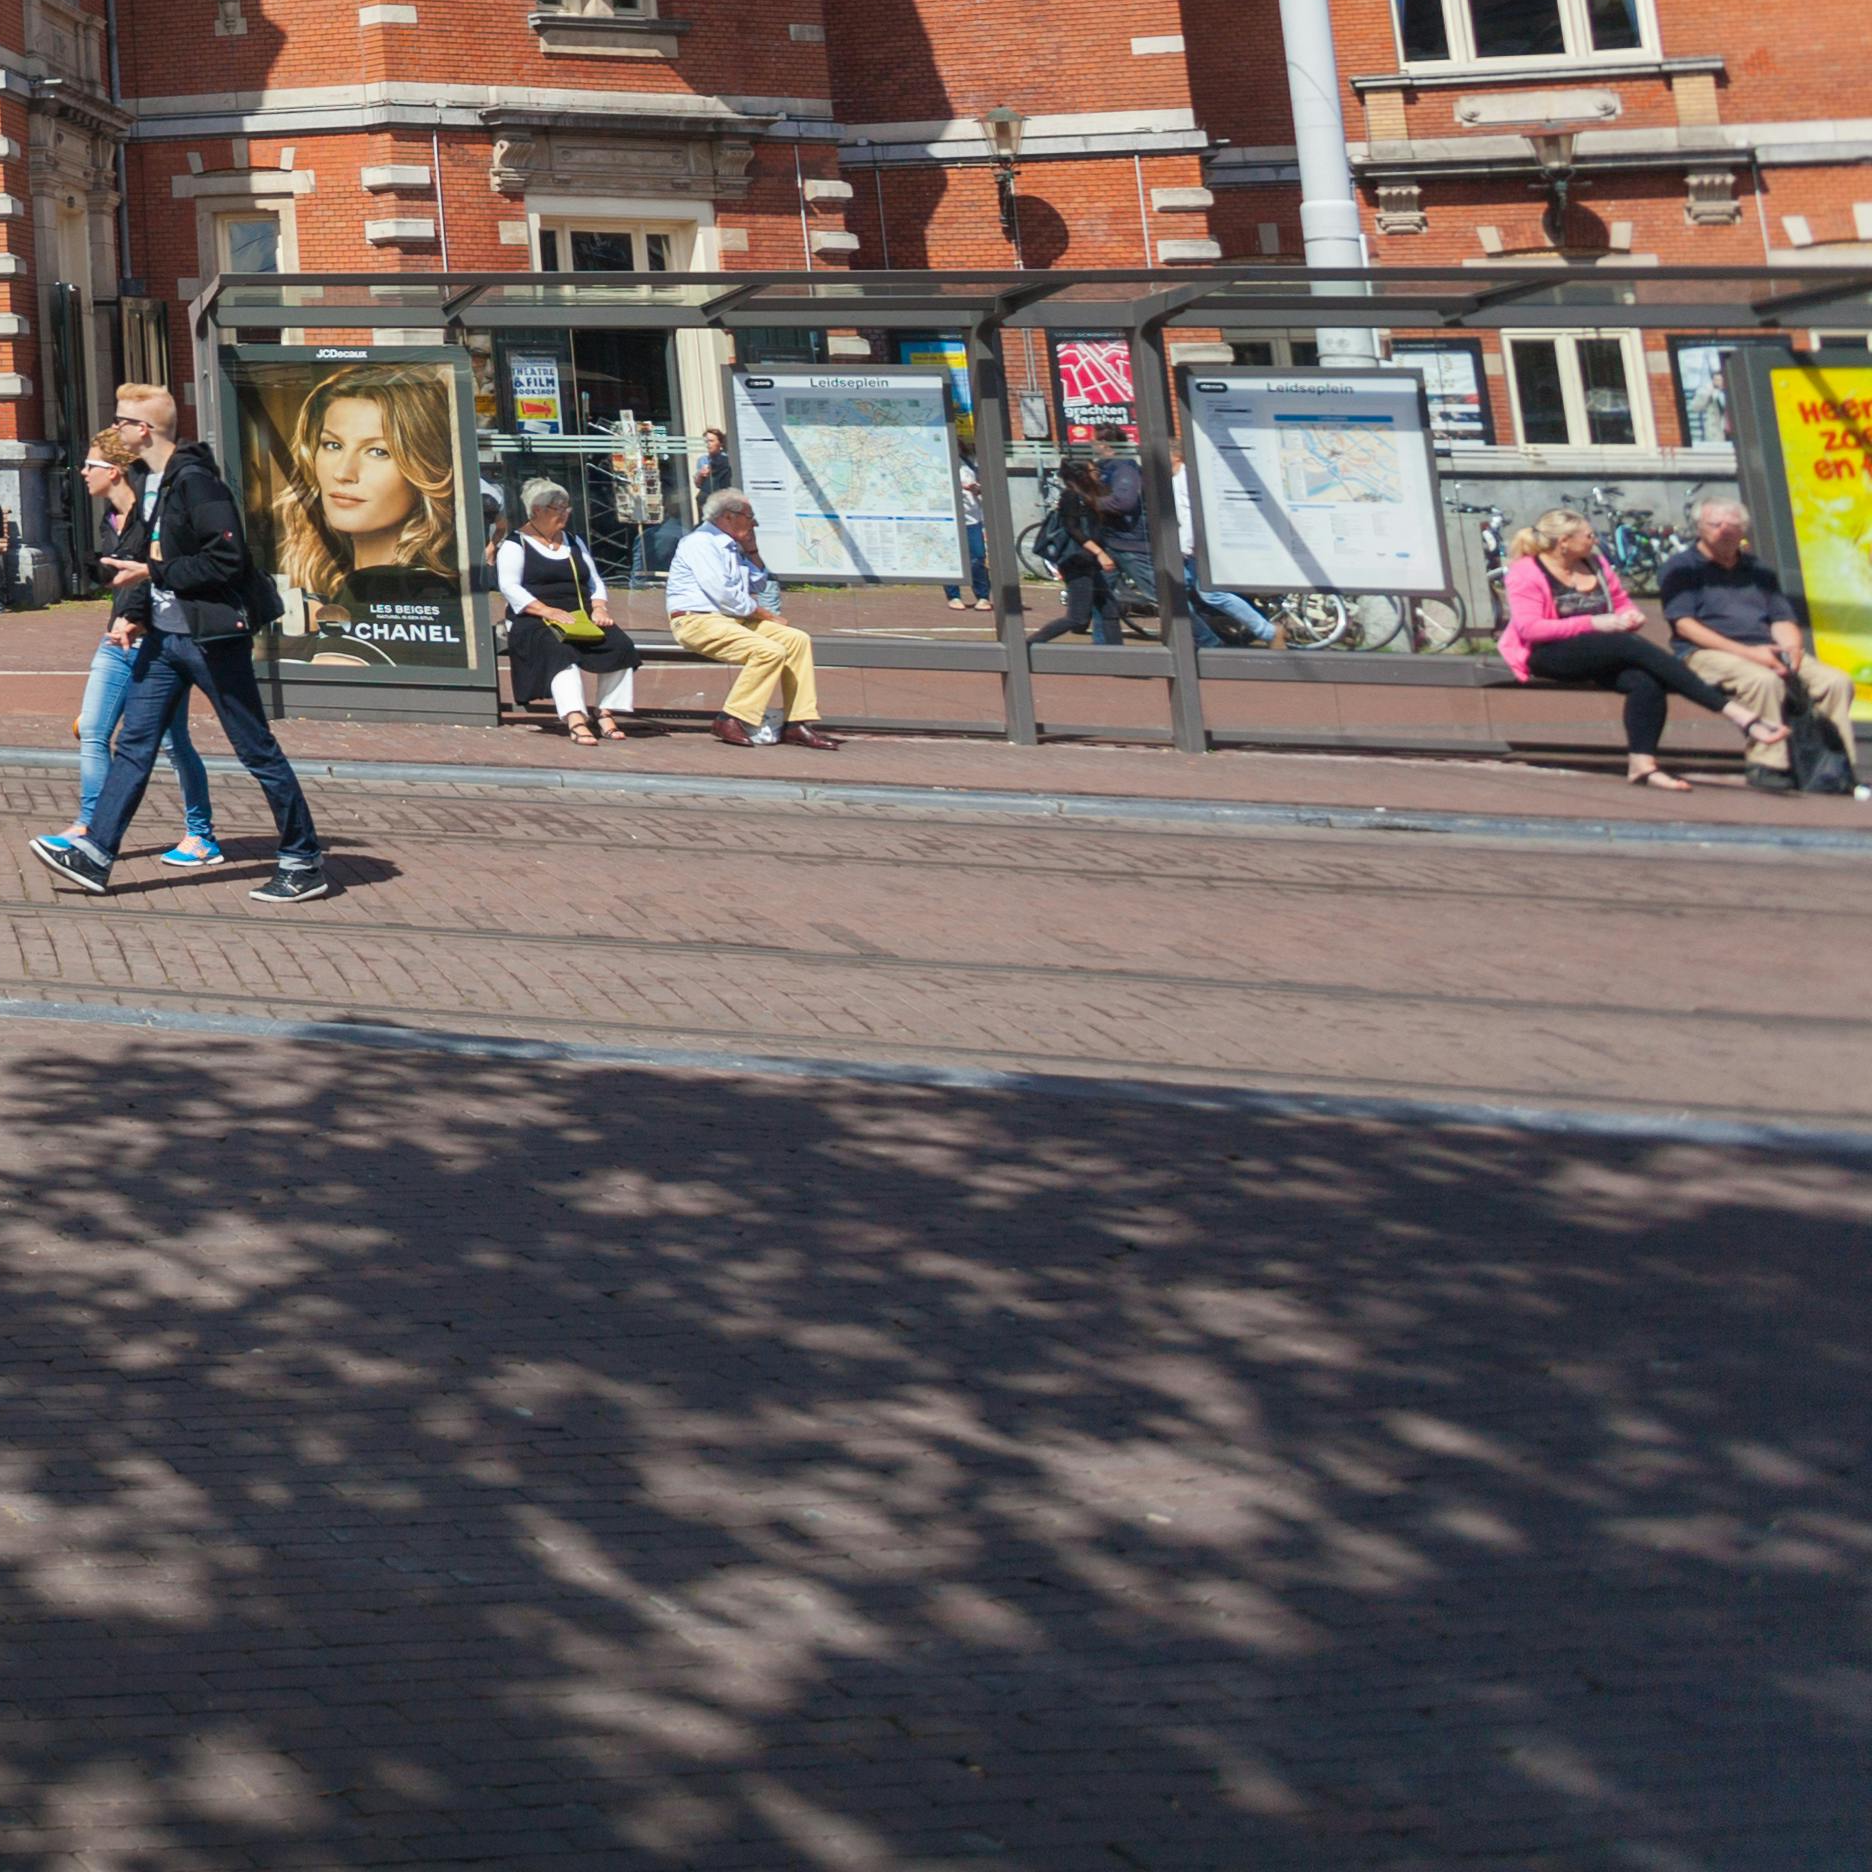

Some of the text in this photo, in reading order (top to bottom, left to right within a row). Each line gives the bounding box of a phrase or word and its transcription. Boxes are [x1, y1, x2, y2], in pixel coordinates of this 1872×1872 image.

[316, 348, 368, 359] JCDecaux
[512, 368, 554, 376] THEATRE
[527, 377, 555, 388] FILM
[810, 377, 889, 389] Leidseplein
[1266, 382, 1355, 396] Leidseplein
[1064, 405, 1128, 418] grachten
[1074, 414, 1129, 425] festival
[1813, 459, 1856, 481] en
[370, 604, 440, 615] LES BEIGES
[354, 622, 460, 643] CHANEL
